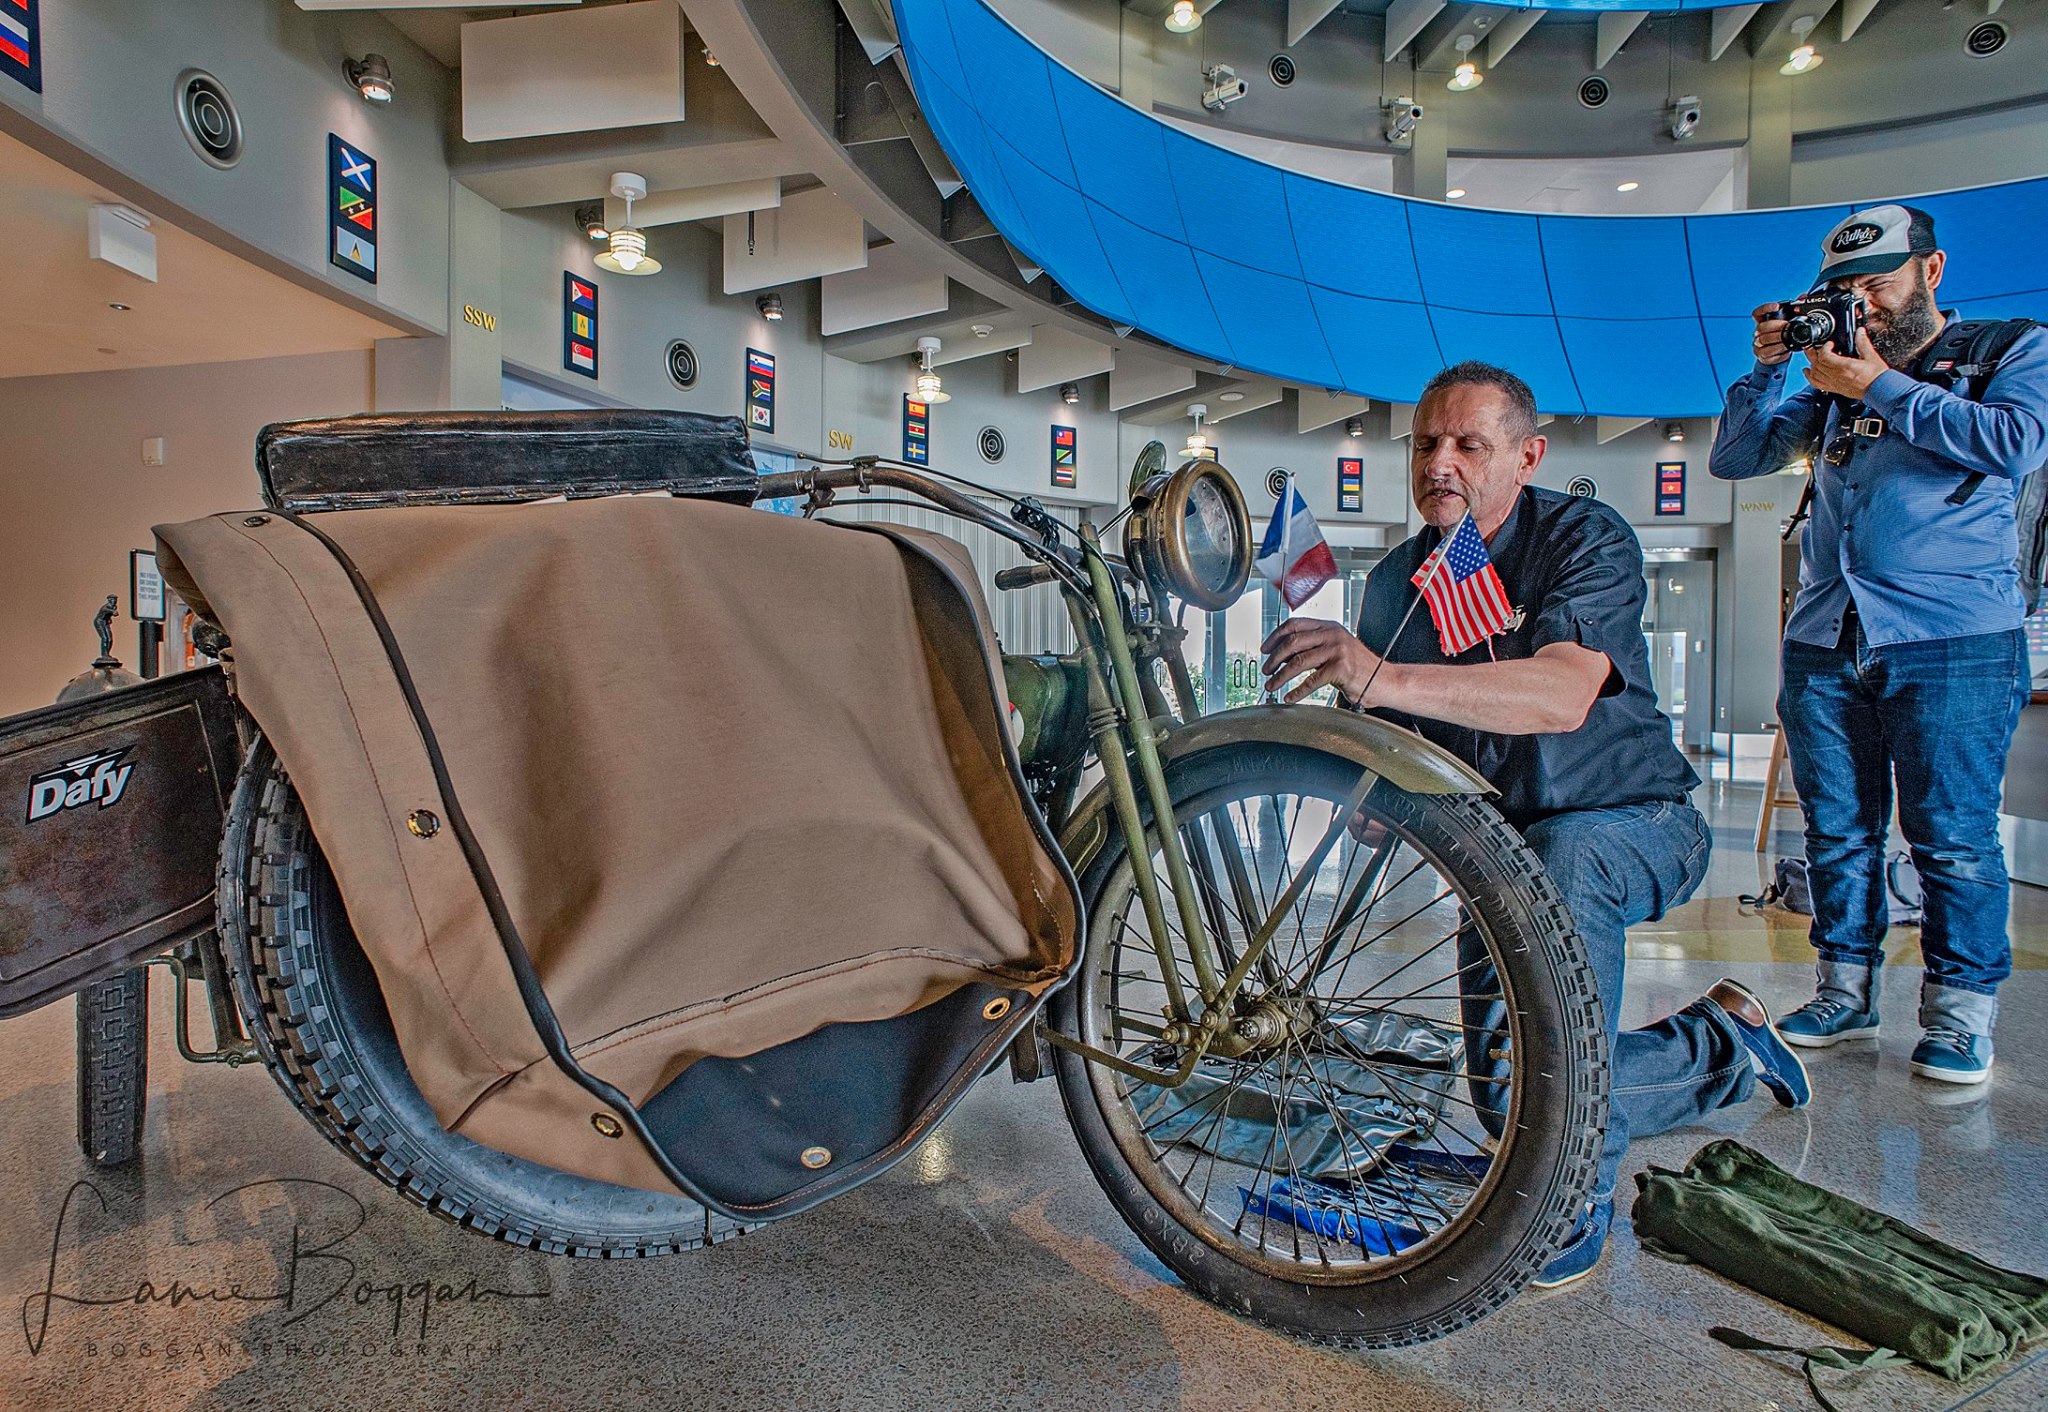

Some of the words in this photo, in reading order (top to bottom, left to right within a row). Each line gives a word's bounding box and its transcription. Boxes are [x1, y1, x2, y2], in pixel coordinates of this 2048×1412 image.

[463, 304, 497, 332] SSW
[829, 430, 854, 450] SW
[1740, 502, 1775, 511] WNW
[30, 760, 132, 820] Dafy
